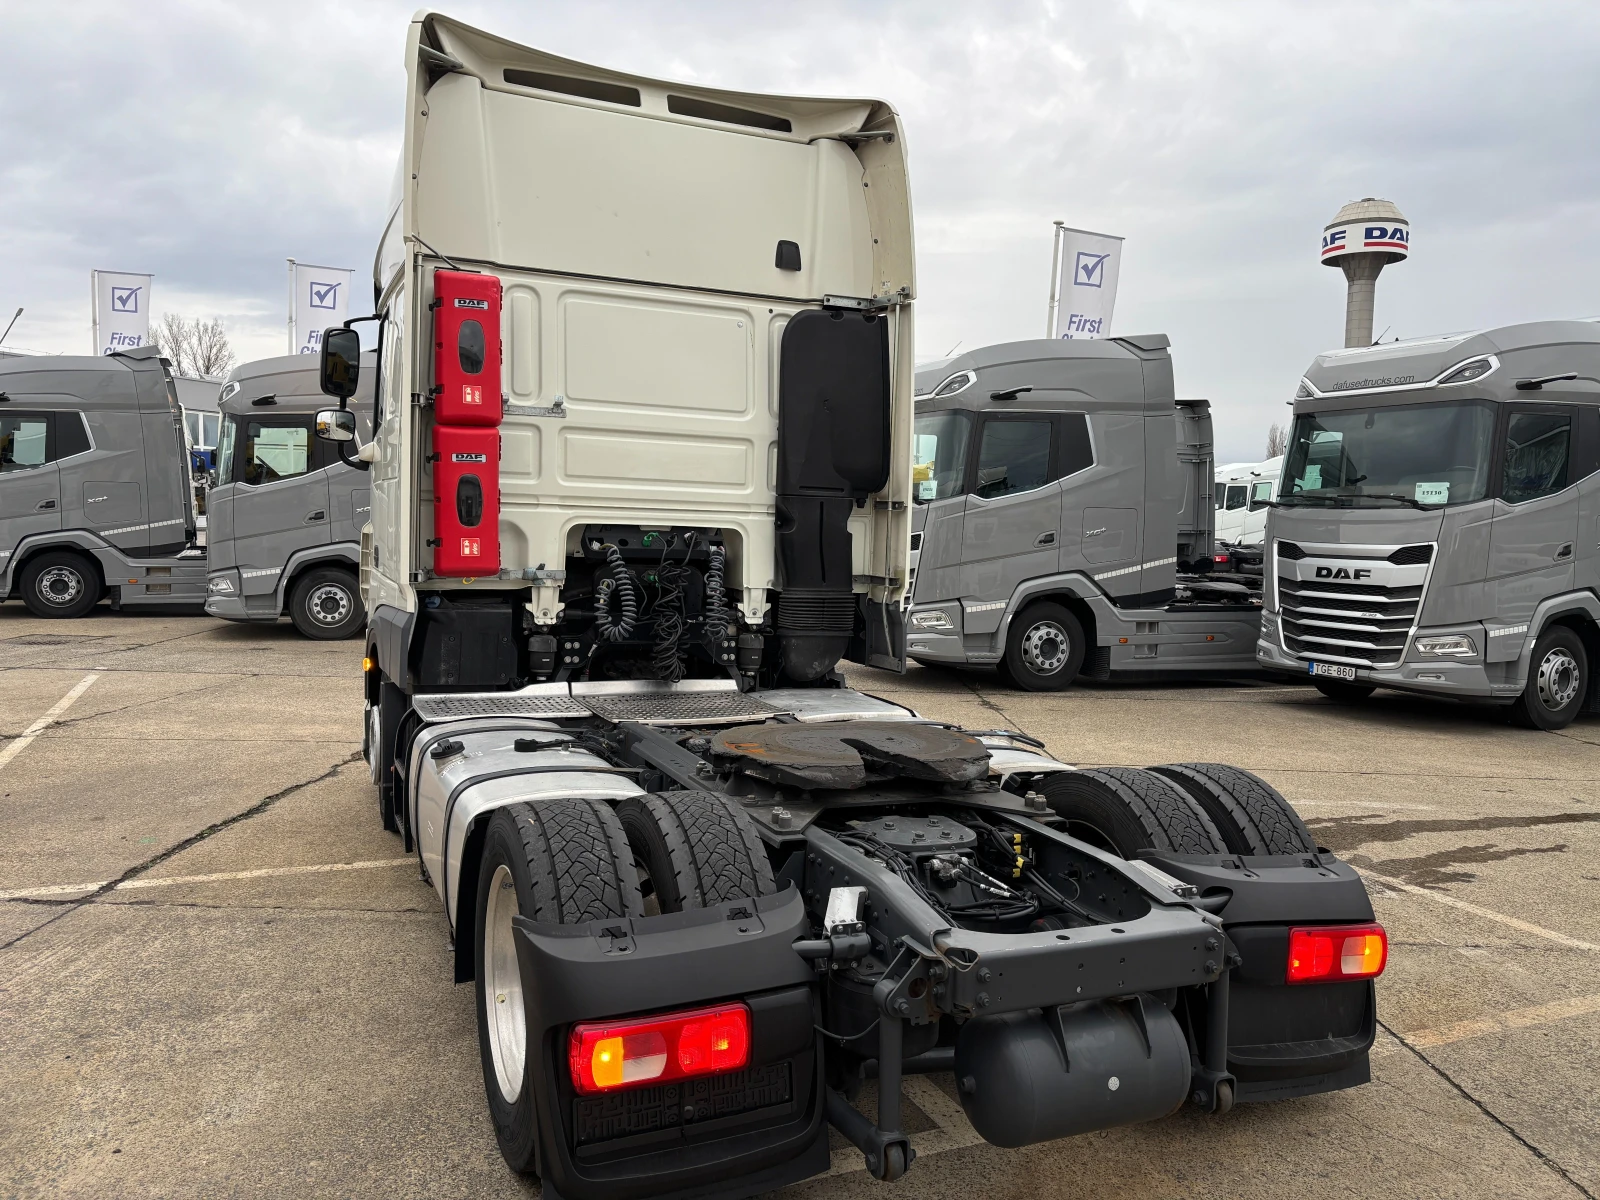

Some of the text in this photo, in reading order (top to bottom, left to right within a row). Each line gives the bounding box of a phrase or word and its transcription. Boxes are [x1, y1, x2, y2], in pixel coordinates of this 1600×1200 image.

[1322, 230, 1346, 249] AF
[1067, 313, 1102, 334] First
[110, 332, 142, 347] First
[1332, 375, 1415, 390] dafusedtrucks.com
[1315, 566, 1371, 580] DAF
[1315, 663, 1354, 678] TGE-860
